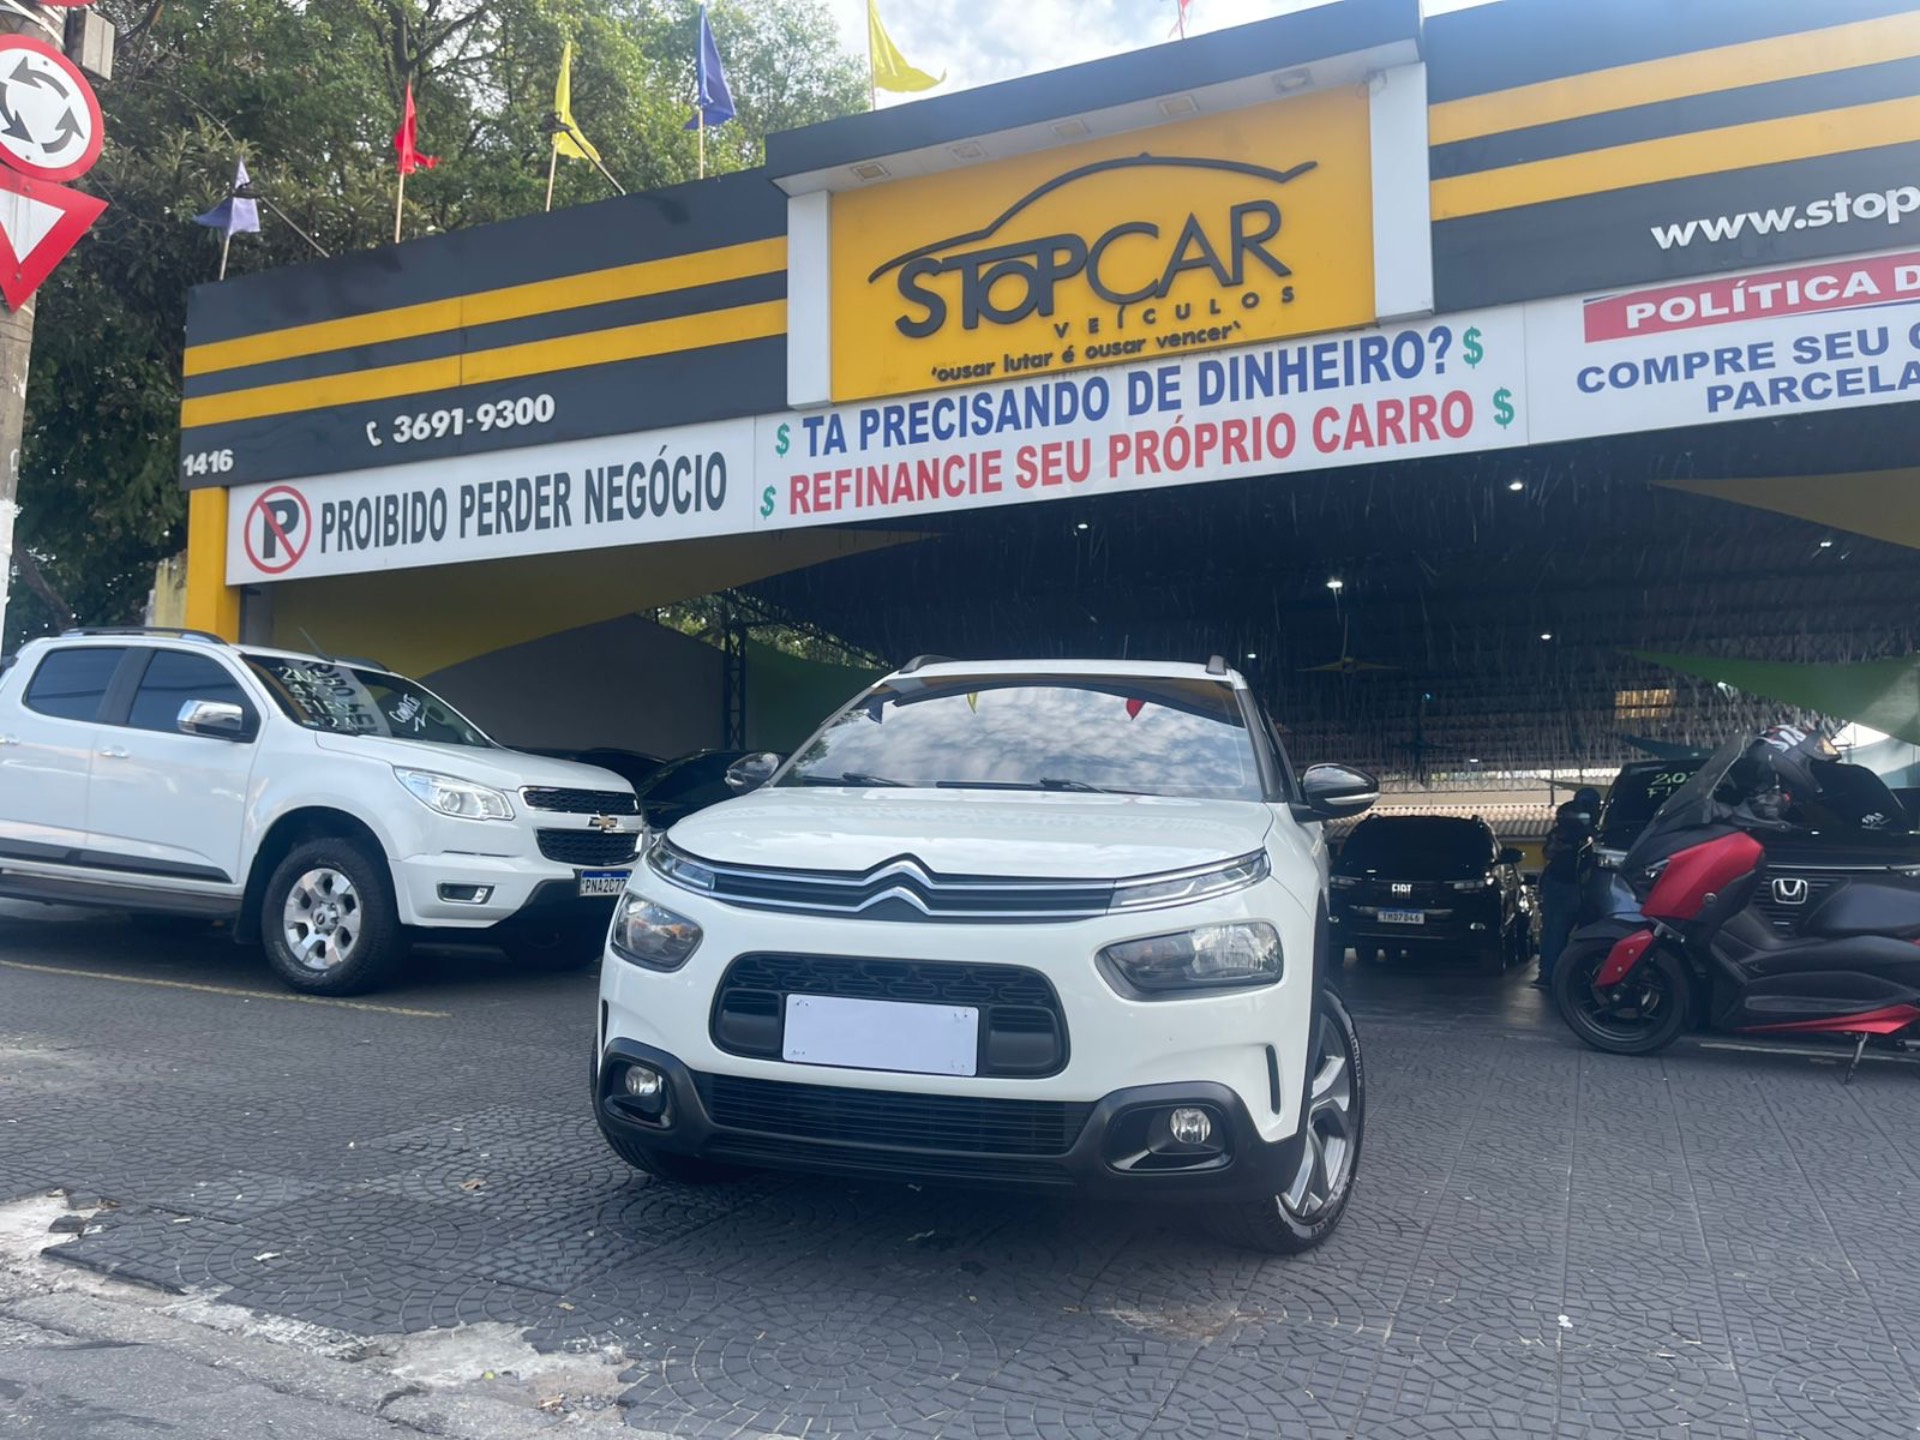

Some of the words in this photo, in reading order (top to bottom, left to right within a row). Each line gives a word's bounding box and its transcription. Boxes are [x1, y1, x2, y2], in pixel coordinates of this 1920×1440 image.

[1650, 185, 1920, 250] www.stop
[894, 199, 1292, 339] STOPCAR
[1626, 270, 1880, 330] POLÍTICA
[1003, 350, 1053, 373] lutar
[1062, 345, 1075, 363] é
[1085, 335, 1146, 360] ousar
[1576, 341, 1776, 394] COMPRE
[1792, 326, 1889, 365] SEU
[393, 394, 556, 444] 3691-9300
[802, 413, 847, 457] TA
[859, 376, 1110, 451] PRECISANDO
[1128, 365, 1182, 416] DE
[1198, 325, 1453, 407] DINHEIRO?
[182, 448, 234, 477] 1416
[789, 449, 1003, 516] REFINANCIE
[1016, 437, 1091, 489] SEU
[1108, 412, 1296, 479] PRÓPRIO
[1312, 389, 1474, 454] CARRO
[320, 487, 448, 554] PROIBIDO
[459, 471, 573, 539] PERDER
[584, 445, 727, 526] NEGÓCIO
